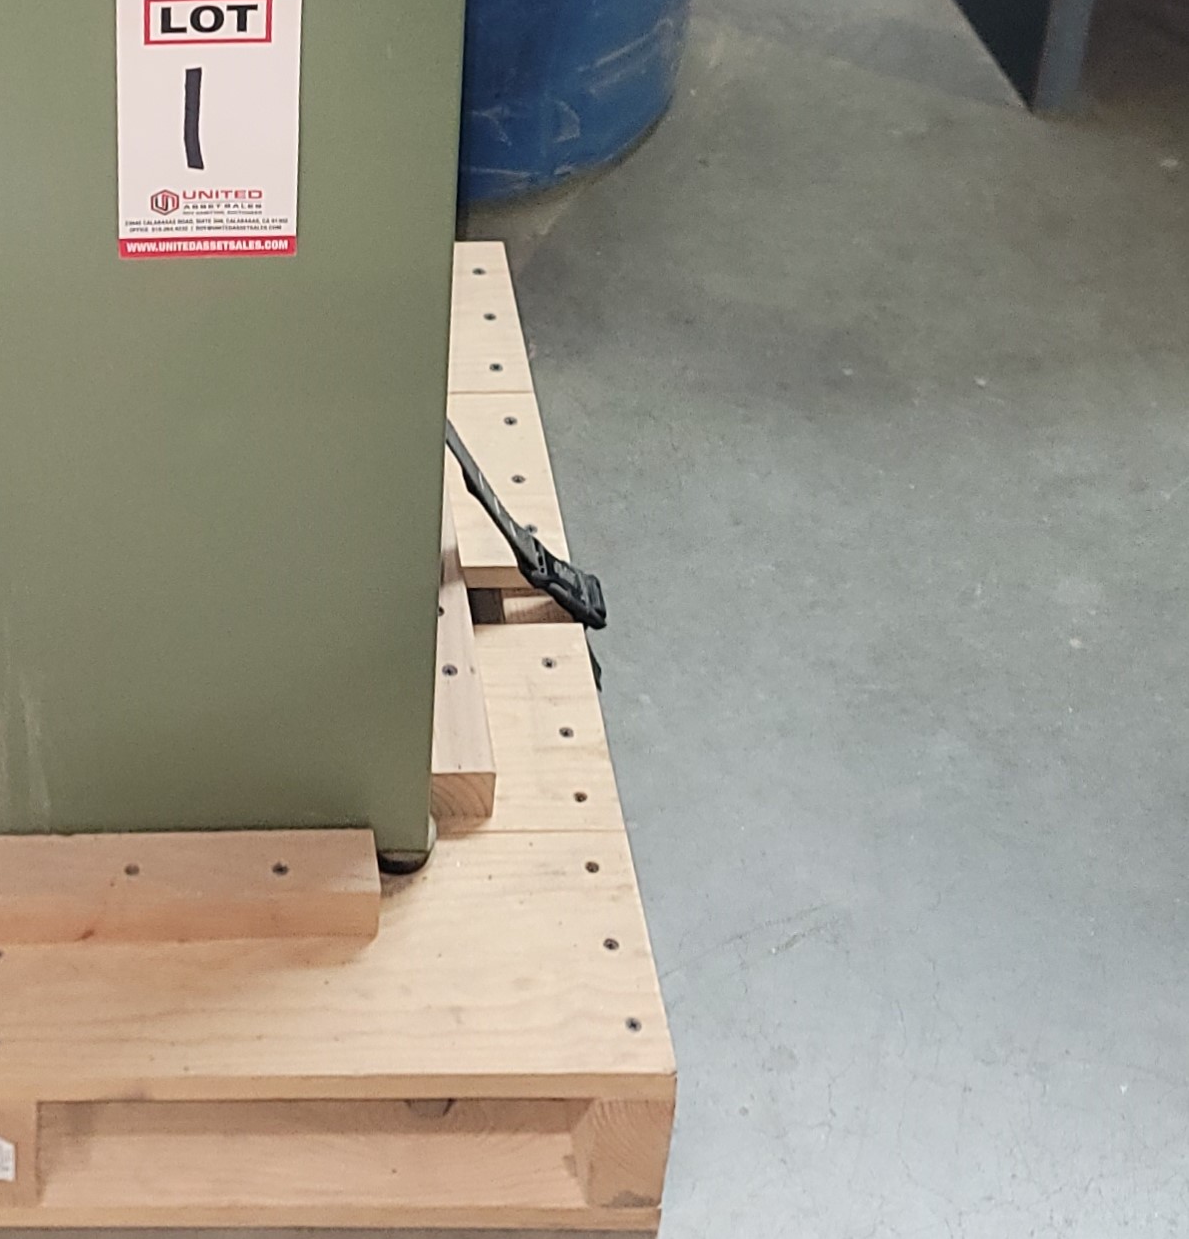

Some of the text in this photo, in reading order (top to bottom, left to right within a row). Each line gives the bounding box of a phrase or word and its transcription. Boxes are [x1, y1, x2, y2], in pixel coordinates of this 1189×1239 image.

[160, 4, 258, 34] LOT
[183, 67, 204, 170] 1
[182, 189, 263, 200] UNITED
[126, 240, 289, 253] WWW.UNITEDASSETSALES.COM
